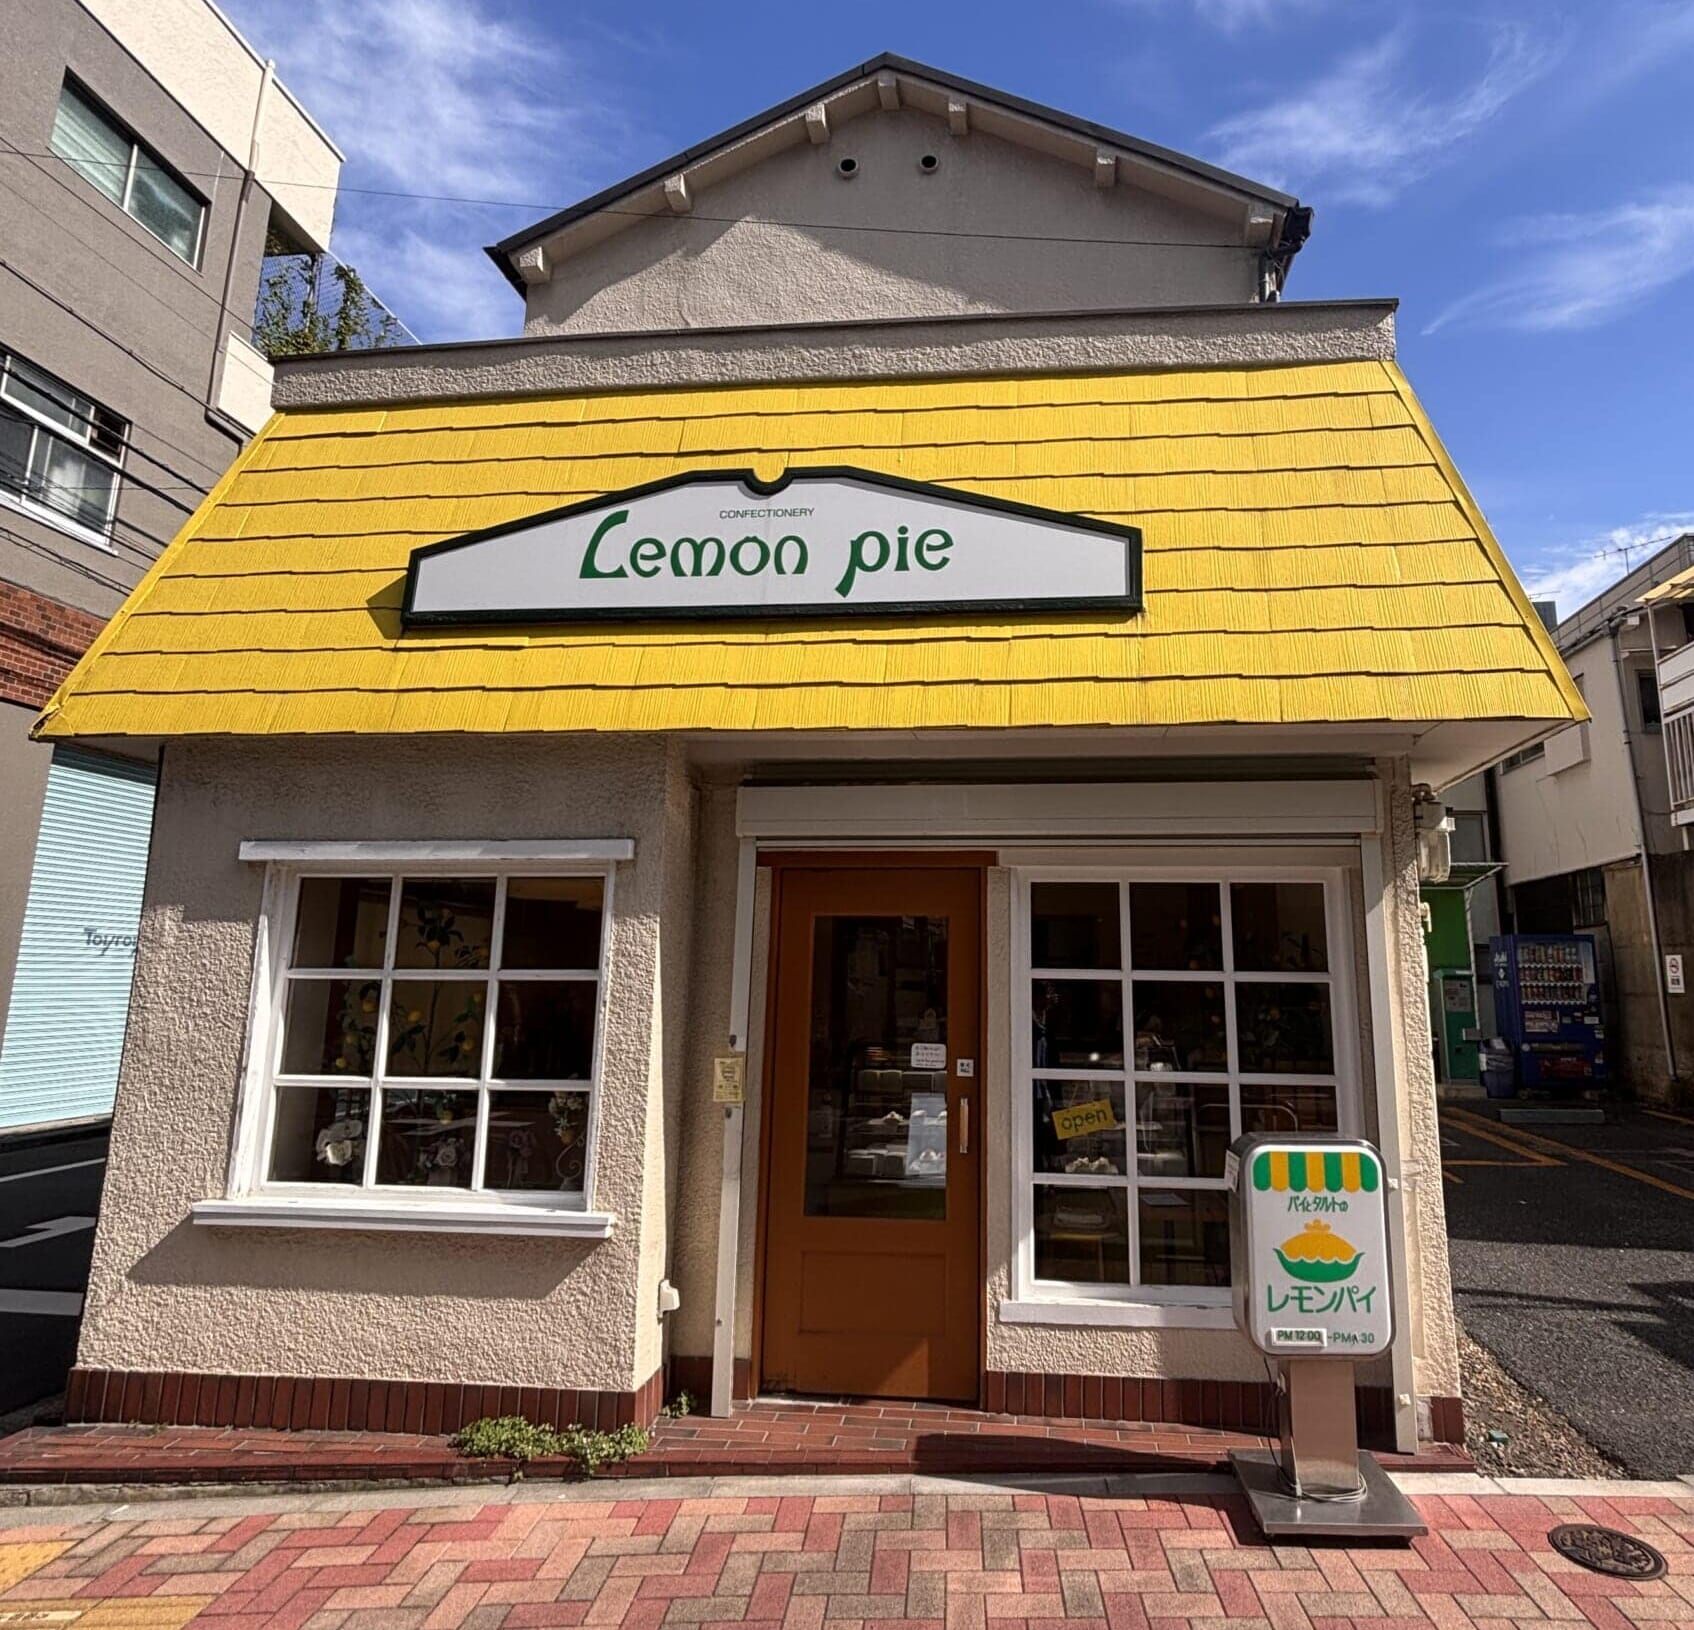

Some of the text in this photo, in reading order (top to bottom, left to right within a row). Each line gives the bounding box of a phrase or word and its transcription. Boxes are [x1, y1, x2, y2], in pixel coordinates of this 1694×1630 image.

[719, 507, 815, 519] CONFECTIONERY
[579, 509, 954, 598] Lemon pie
[1061, 1109, 1107, 1132] open
[1287, 1195, 1349, 1213] パイとタルトの
[1267, 1284, 1377, 1314] レモンパイ
[1277, 1330, 1293, 1341] PM
